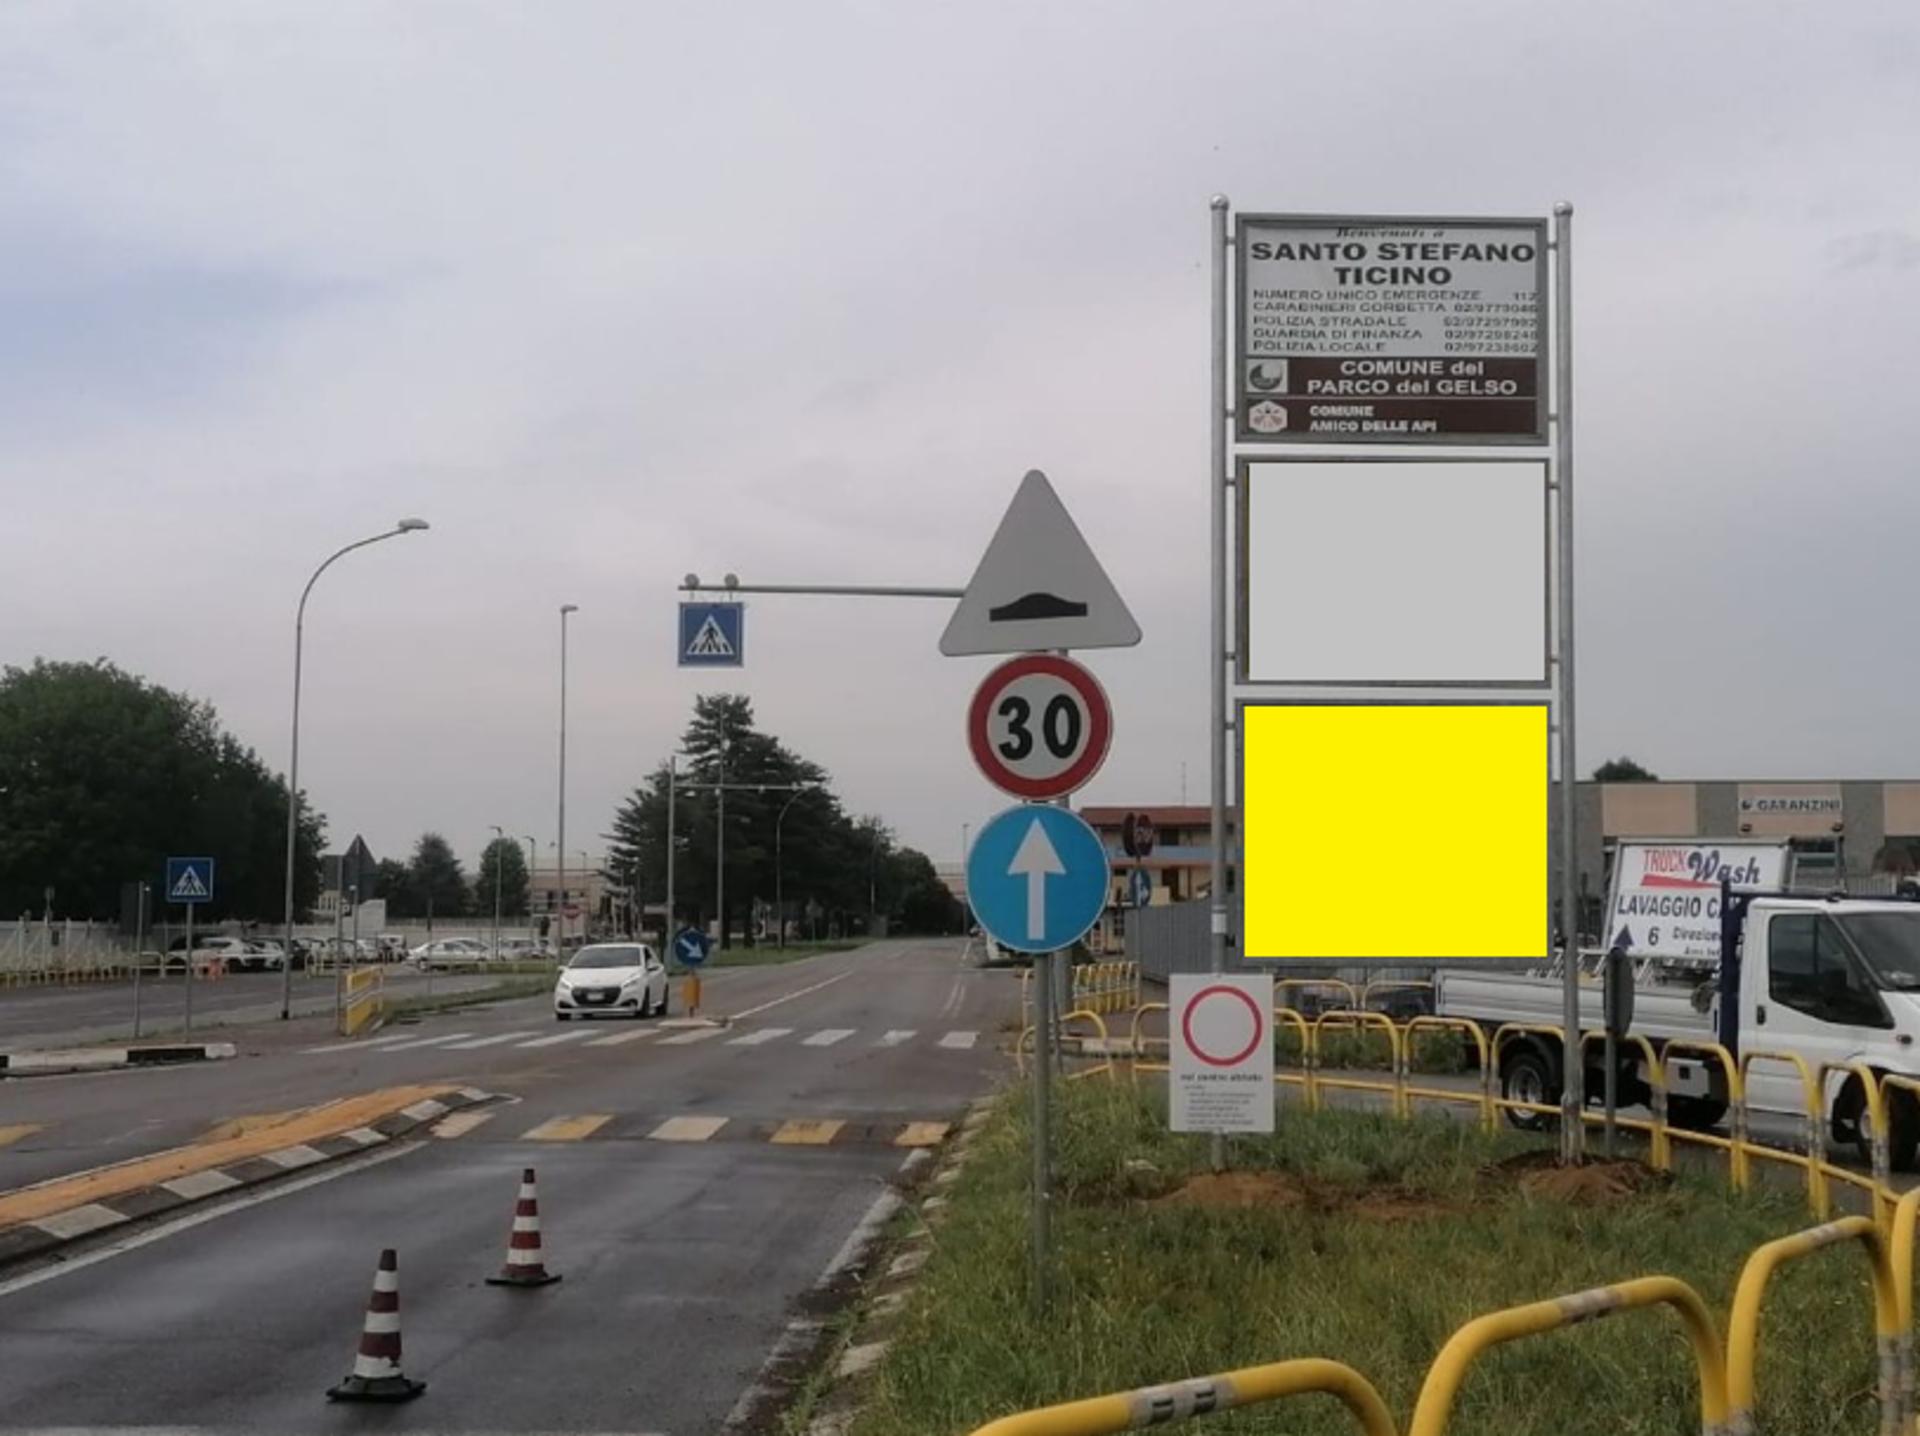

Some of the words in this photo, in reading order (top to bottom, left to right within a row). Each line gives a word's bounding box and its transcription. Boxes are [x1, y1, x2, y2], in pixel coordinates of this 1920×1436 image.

[1251, 242, 1368, 261] SANTO
[1377, 243, 1535, 262] STEFANO
[1334, 266, 1452, 285] TICINO
[1253, 289, 1323, 300] NUMERO
[1327, 290, 1378, 300] UNICO
[1382, 290, 1482, 300] EMERGENZE
[1253, 302, 1356, 313] CARABINIERI
[1359, 302, 1446, 313] CORBETTA
[1253, 315, 1316, 326] POLIZIA
[1318, 316, 1407, 327] STRADALE
[1253, 328, 1327, 338] GUARDIA
[1331, 329, 1347, 339] DI
[1351, 329, 1423, 339] FINANZA
[1253, 340, 1316, 351] POLIZIA
[1319, 341, 1388, 352] LOCALE
[1340, 360, 1444, 375] COMUNE
[1450, 360, 1484, 375] del
[1307, 379, 1389, 394] PARCO
[1396, 379, 1430, 394] del
[1436, 379, 1518, 395] GELSO
[1309, 405, 1374, 417] COMUNE
[1309, 419, 1359, 432] AMICO
[1362, 420, 1409, 432] DELLE
[1411, 420, 1437, 432] API
[998, 694, 1082, 761] 30
[1758, 799, 1840, 811] GARANZINI
[1643, 849, 1689, 873] TRUCK
[1687, 850, 1761, 883] Wash
[1617, 894, 1702, 918] LAVAGGIO
[1647, 926, 1661, 946] 6
